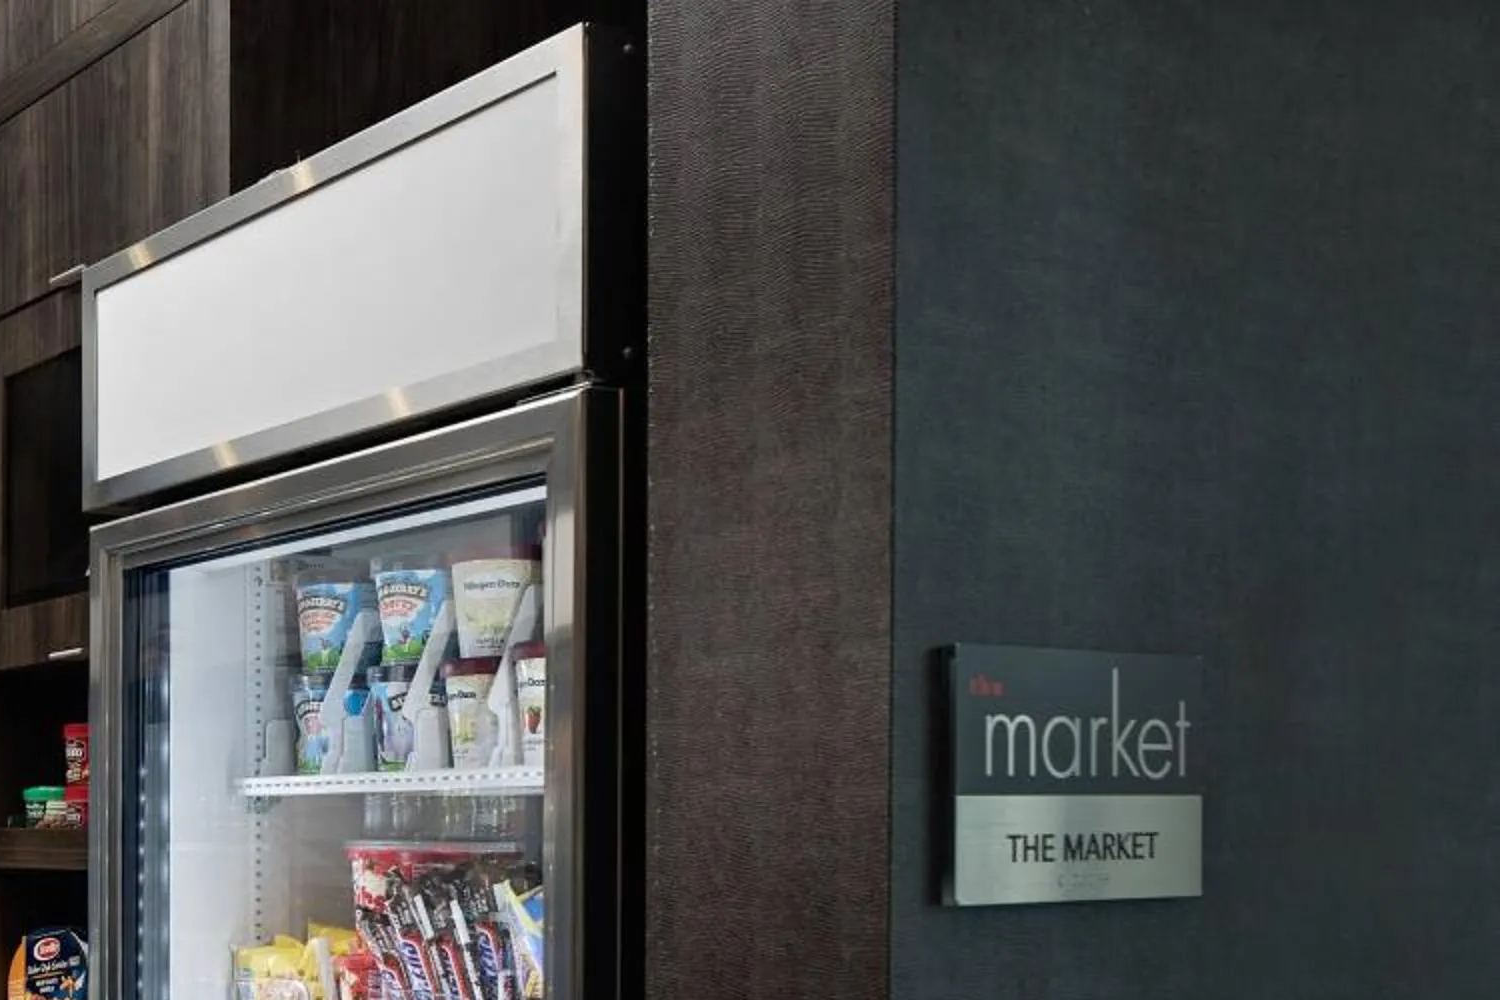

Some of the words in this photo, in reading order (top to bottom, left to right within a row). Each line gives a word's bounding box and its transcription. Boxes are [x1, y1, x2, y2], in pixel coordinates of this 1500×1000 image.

[984, 667, 1192, 779] market
[1006, 833, 1055, 863] THE
[1062, 831, 1160, 862] MARKET
